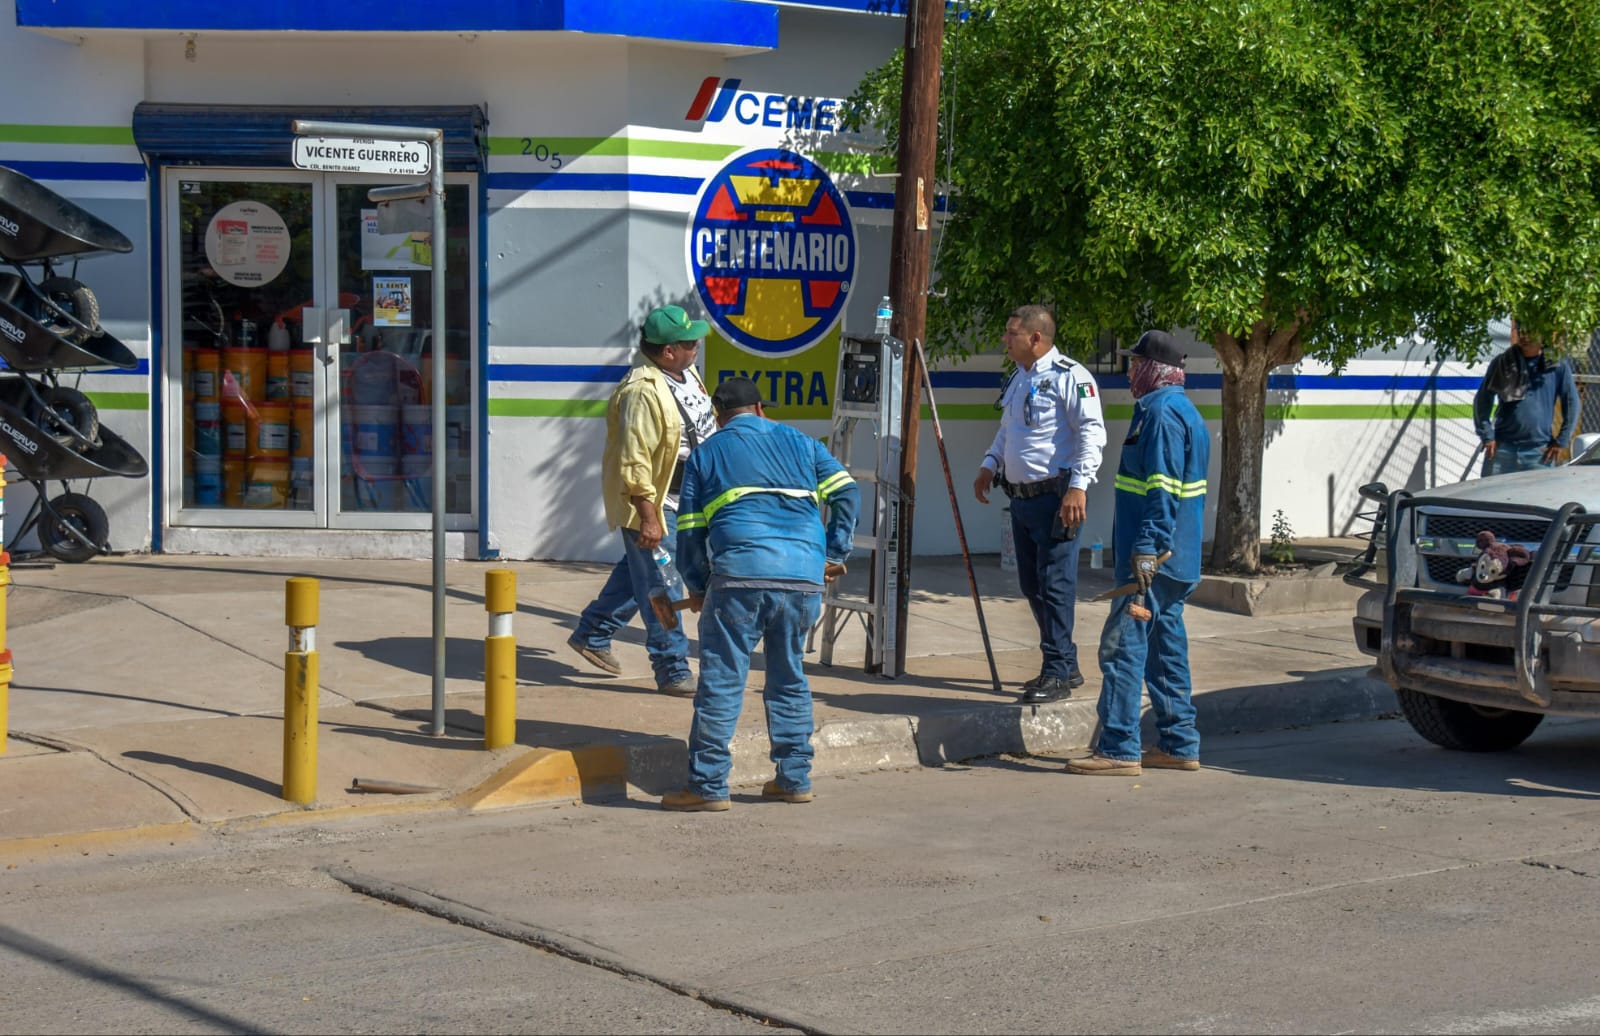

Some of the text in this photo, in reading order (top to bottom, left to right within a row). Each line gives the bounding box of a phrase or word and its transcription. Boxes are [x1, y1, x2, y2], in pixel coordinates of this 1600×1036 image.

[735, 93, 862, 134] CEMEX
[305, 145, 420, 163] VICENTE GUERRERO
[521, 137, 562, 170] 205
[696, 227, 849, 273] CENTENARIO
[0, 317, 26, 340] ERVO
[718, 370, 828, 405] TRA
[2, 423, 39, 452] CUERVO
